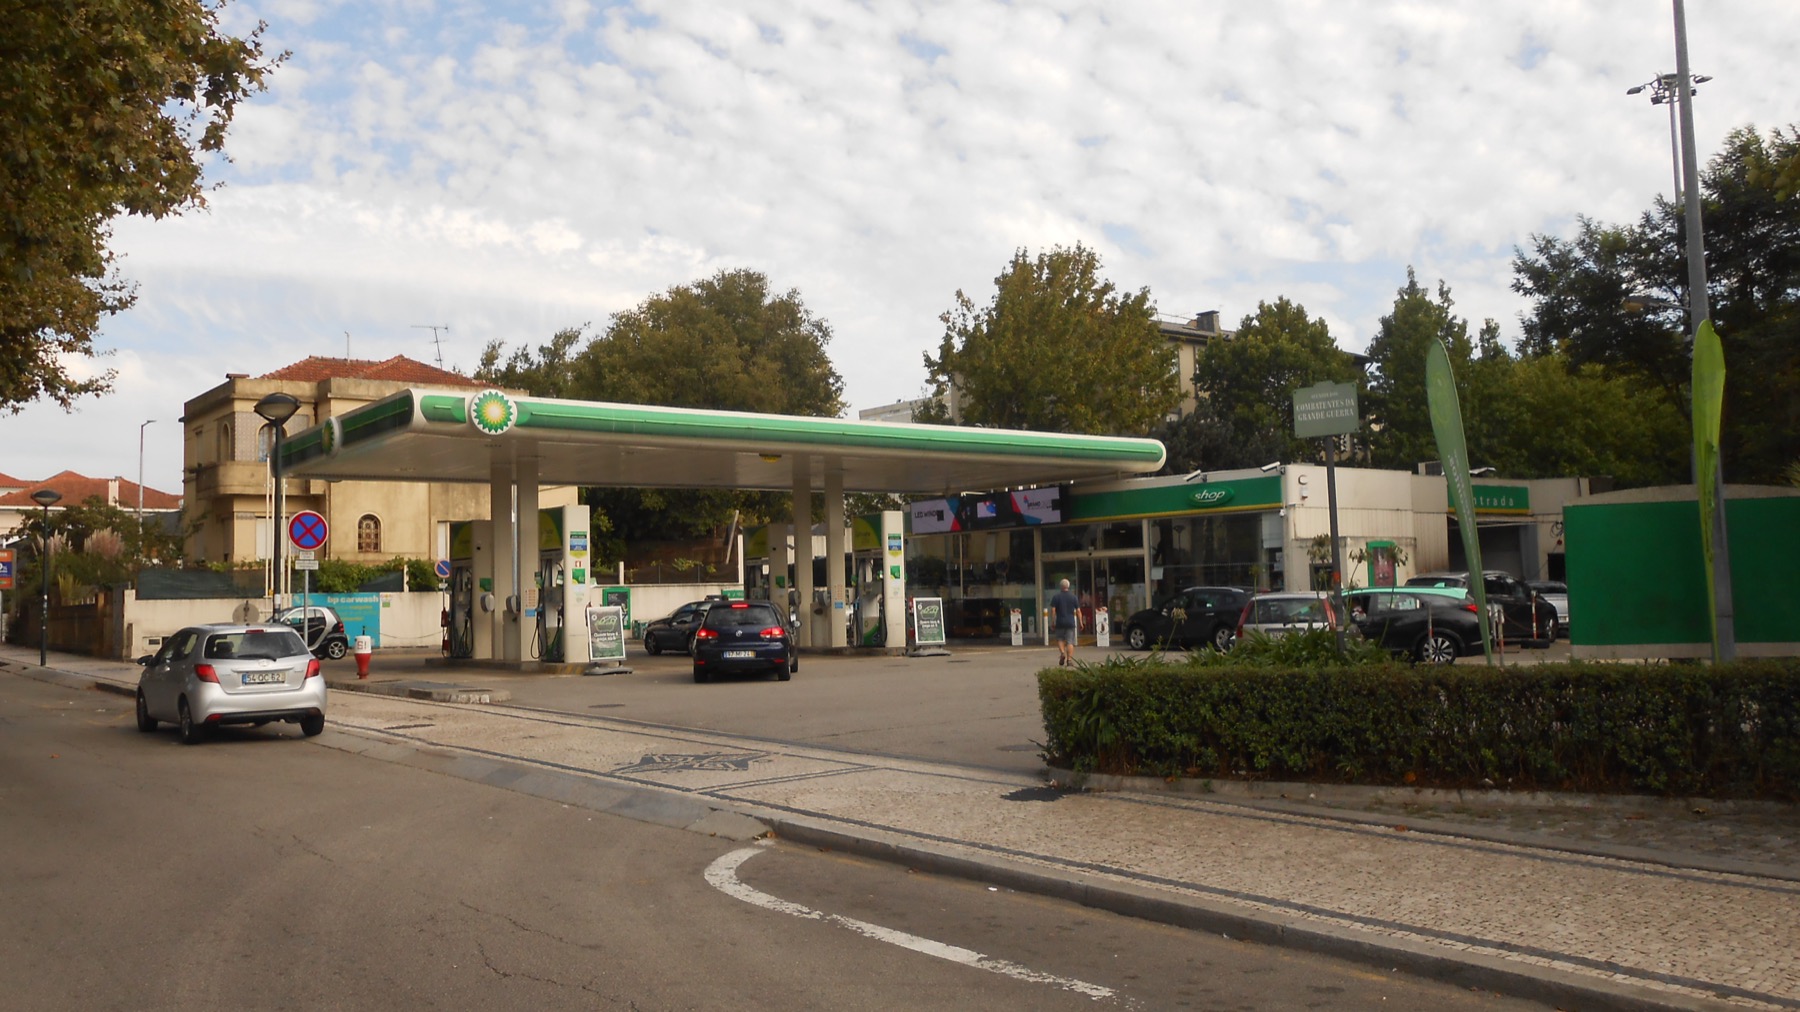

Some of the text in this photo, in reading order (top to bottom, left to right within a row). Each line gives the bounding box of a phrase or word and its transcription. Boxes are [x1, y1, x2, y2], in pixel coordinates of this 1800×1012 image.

[1296, 398, 1354, 411] COMBATENTES DA
[1297, 408, 1354, 421] GRANDE GUERRA
[1194, 489, 1226, 502] shop
[1472, 496, 1515, 506] ntrada
[327, 595, 379, 605] bp carwash
